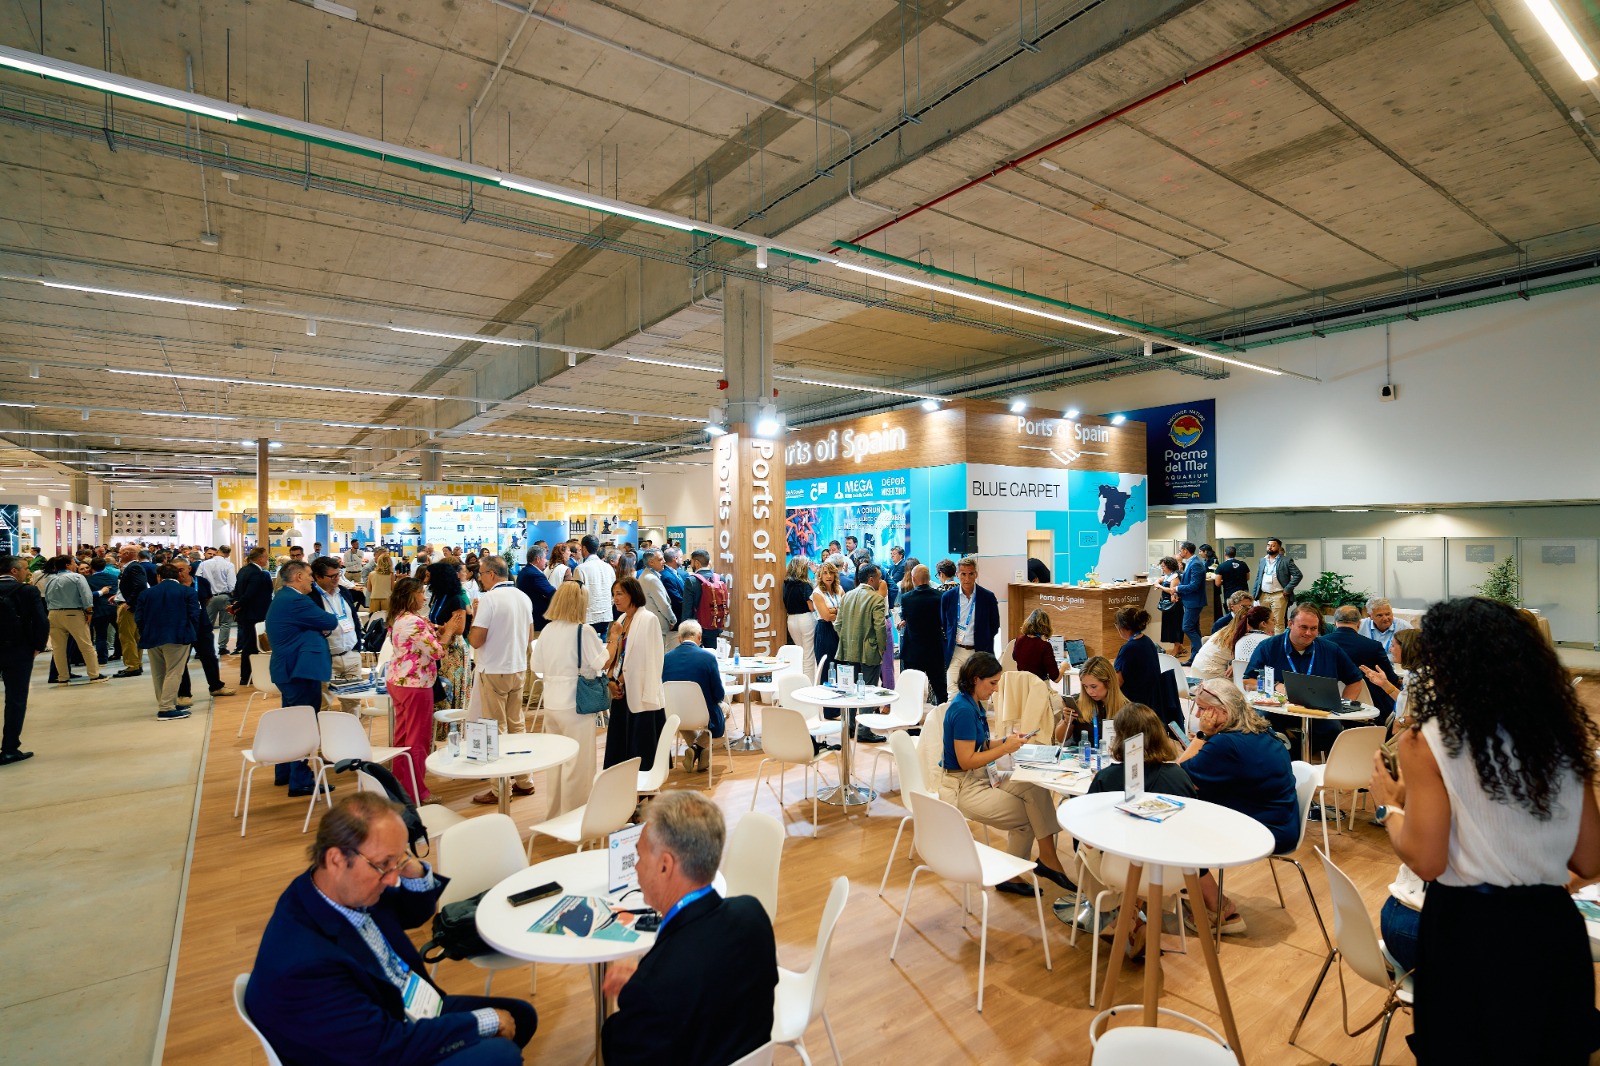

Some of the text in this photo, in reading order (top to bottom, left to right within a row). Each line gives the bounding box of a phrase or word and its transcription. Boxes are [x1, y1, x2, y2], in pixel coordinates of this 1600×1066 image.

[1017, 416, 1053, 437] Ports
[1074, 423, 1109, 444] Spain
[815, 429, 838, 462] of
[842, 422, 907, 464] Spain
[1164, 449, 1208, 461] Poema
[1165, 460, 1208, 473] del Mar
[972, 481, 1060, 498] BLUE CARPET
[719, 530, 734, 564] of
[747, 441, 777, 657] Ports of Spain
[1040, 593, 1056, 602] Ports
[1065, 596, 1085, 604] Spain
[1127, 595, 1140, 603] Spain
